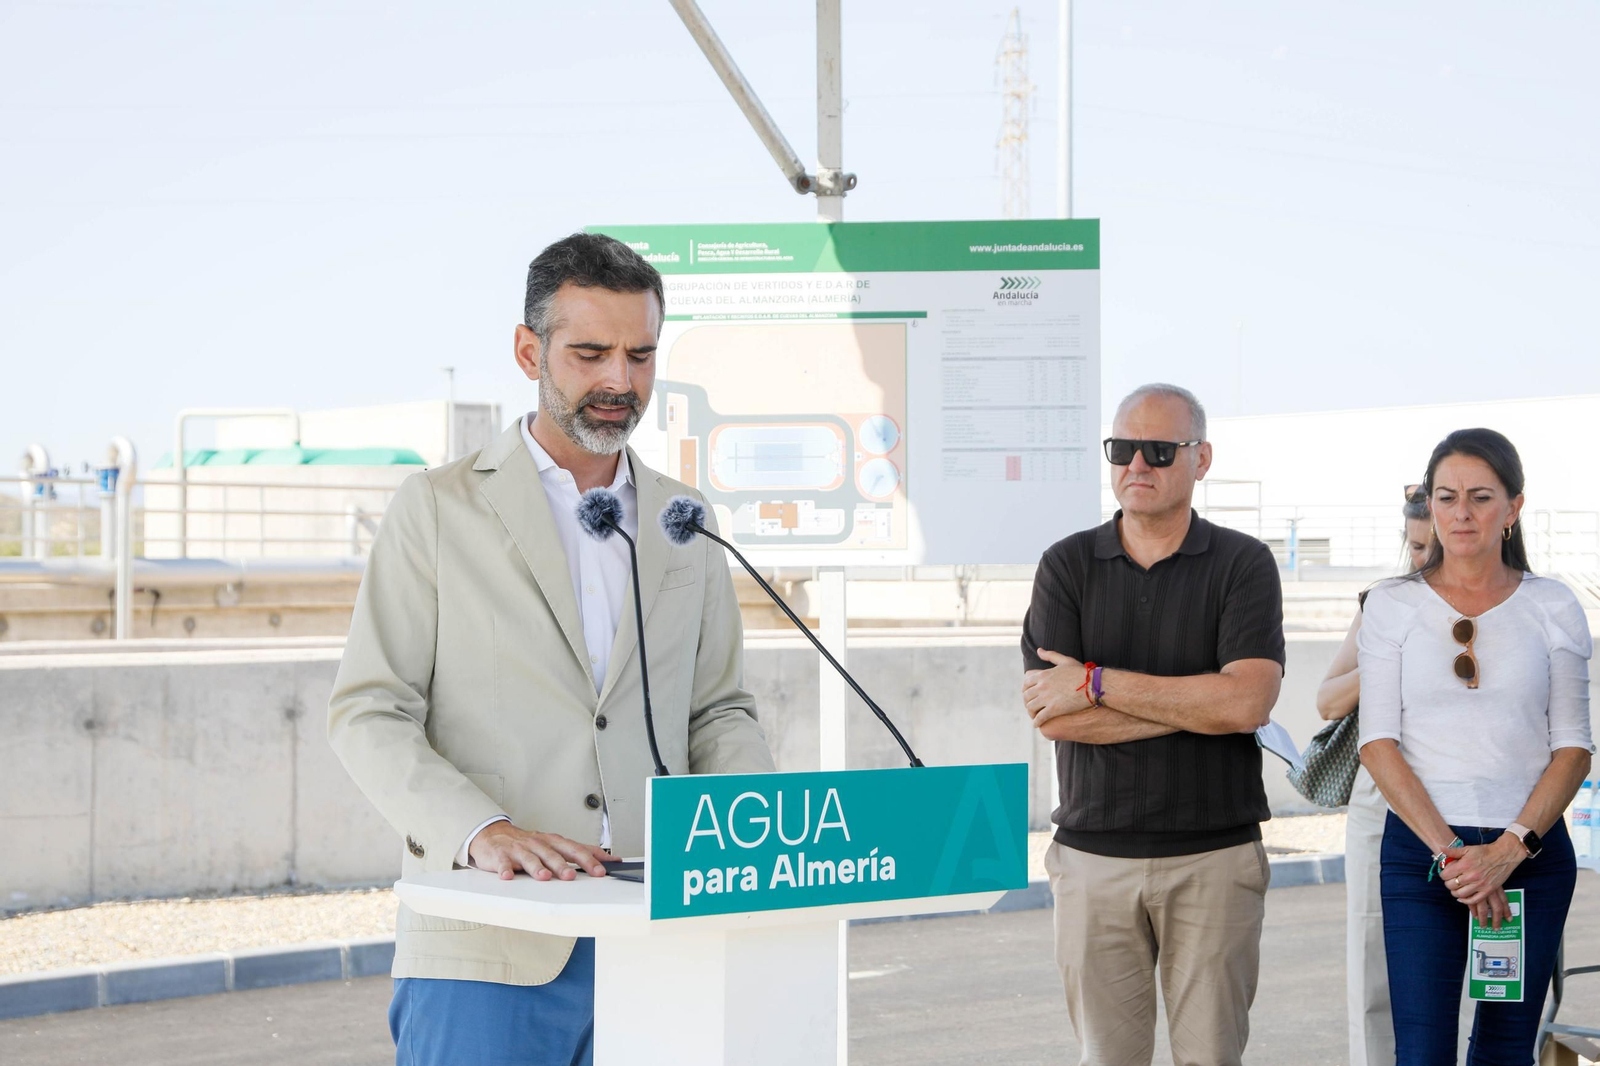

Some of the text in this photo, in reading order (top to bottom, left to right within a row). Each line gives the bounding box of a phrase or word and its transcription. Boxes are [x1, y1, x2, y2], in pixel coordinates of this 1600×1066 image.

[969, 243, 1084, 255] www.juntadeandalucia.es
[642, 251, 680, 263] ndalucía
[733, 281, 748, 291] DE
[750, 280, 803, 290] VERTIDOS
[806, 280, 814, 290] Y
[856, 279, 871, 289] DE
[670, 296, 713, 305] CUEVAS
[715, 295, 736, 305] DEL
[738, 294, 804, 305] ALMANZORA
[992, 290, 1039, 300] Andalucía
[684, 787, 852, 853] AGUA
[683, 846, 897, 906] para Almería
